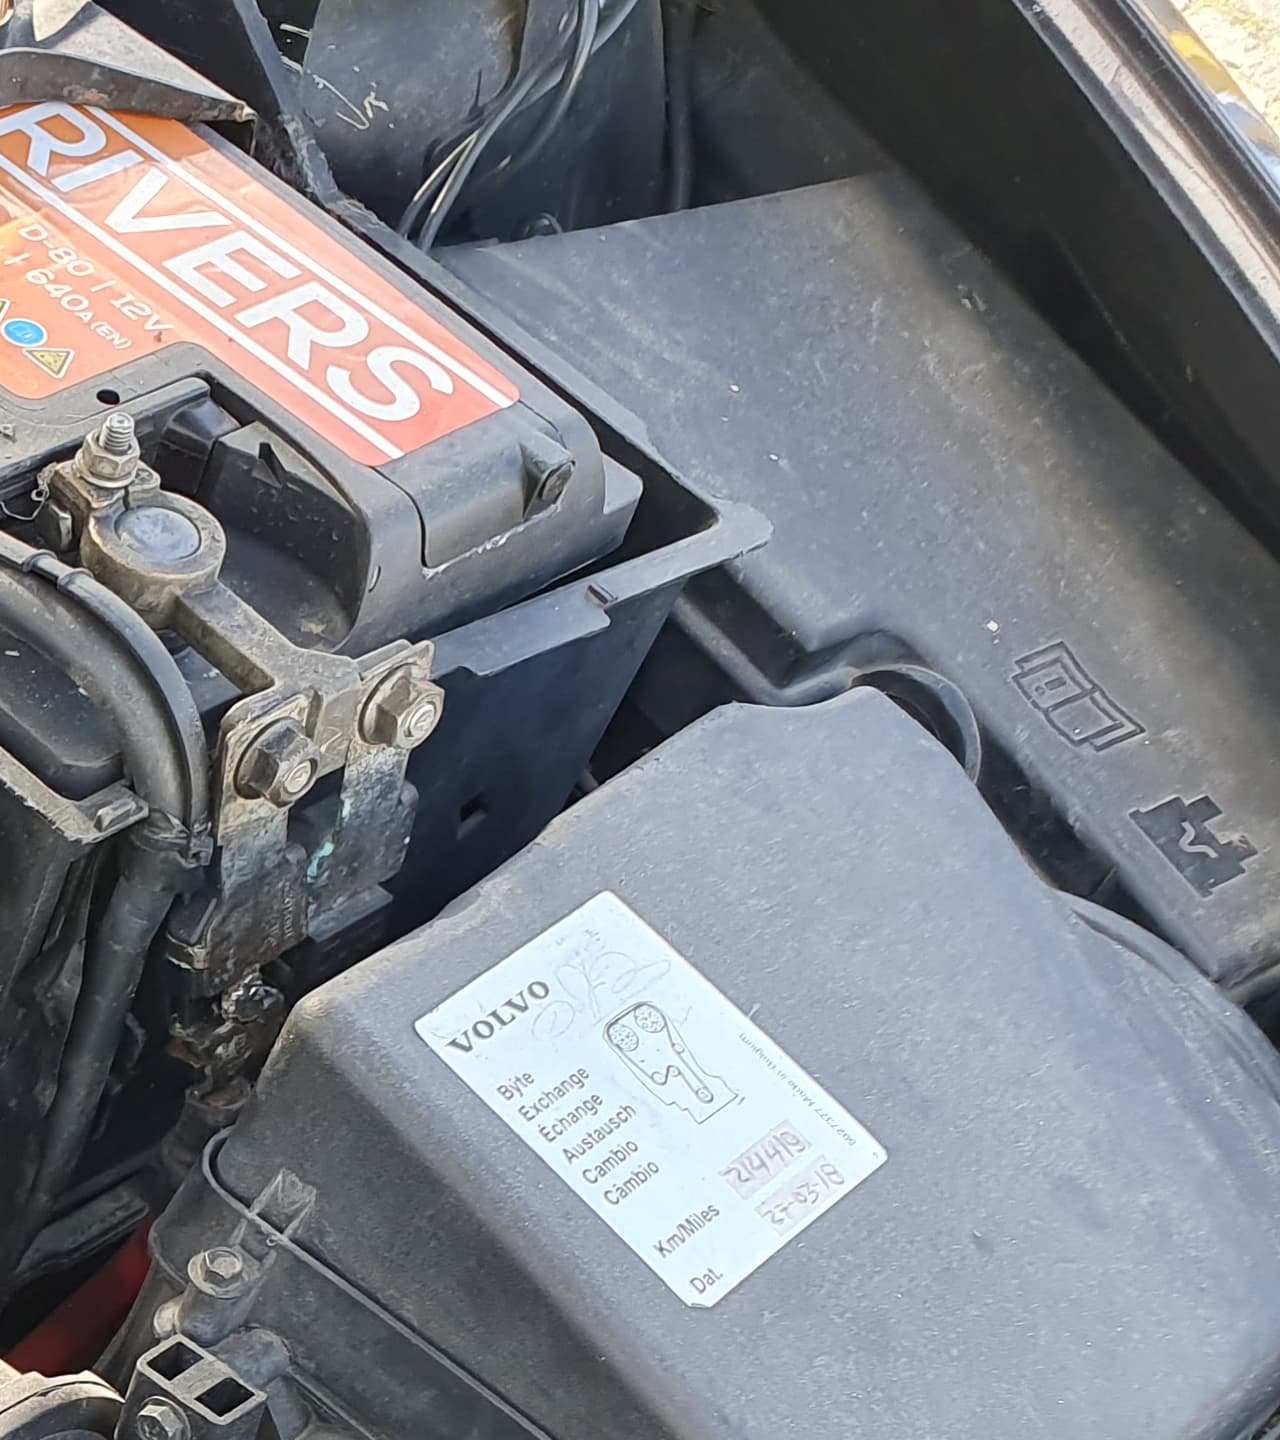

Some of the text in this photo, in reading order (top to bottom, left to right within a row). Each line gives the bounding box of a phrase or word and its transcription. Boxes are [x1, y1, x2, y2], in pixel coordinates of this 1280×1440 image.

[19, 223, 94, 276] D-80
[111, 291, 175, 332] 12V
[445, 981, 550, 1053] VOLVO
[496, 1071, 535, 1101] Byte
[517, 1067, 590, 1122] Exchange
[537, 1093, 604, 1143] Échange
[561, 1103, 637, 1165] Austausch
[582, 1139, 639, 1184] Cambio
[652, 1203, 720, 1259] Km/Miles
[689, 1267, 724, 1295] Dat.
